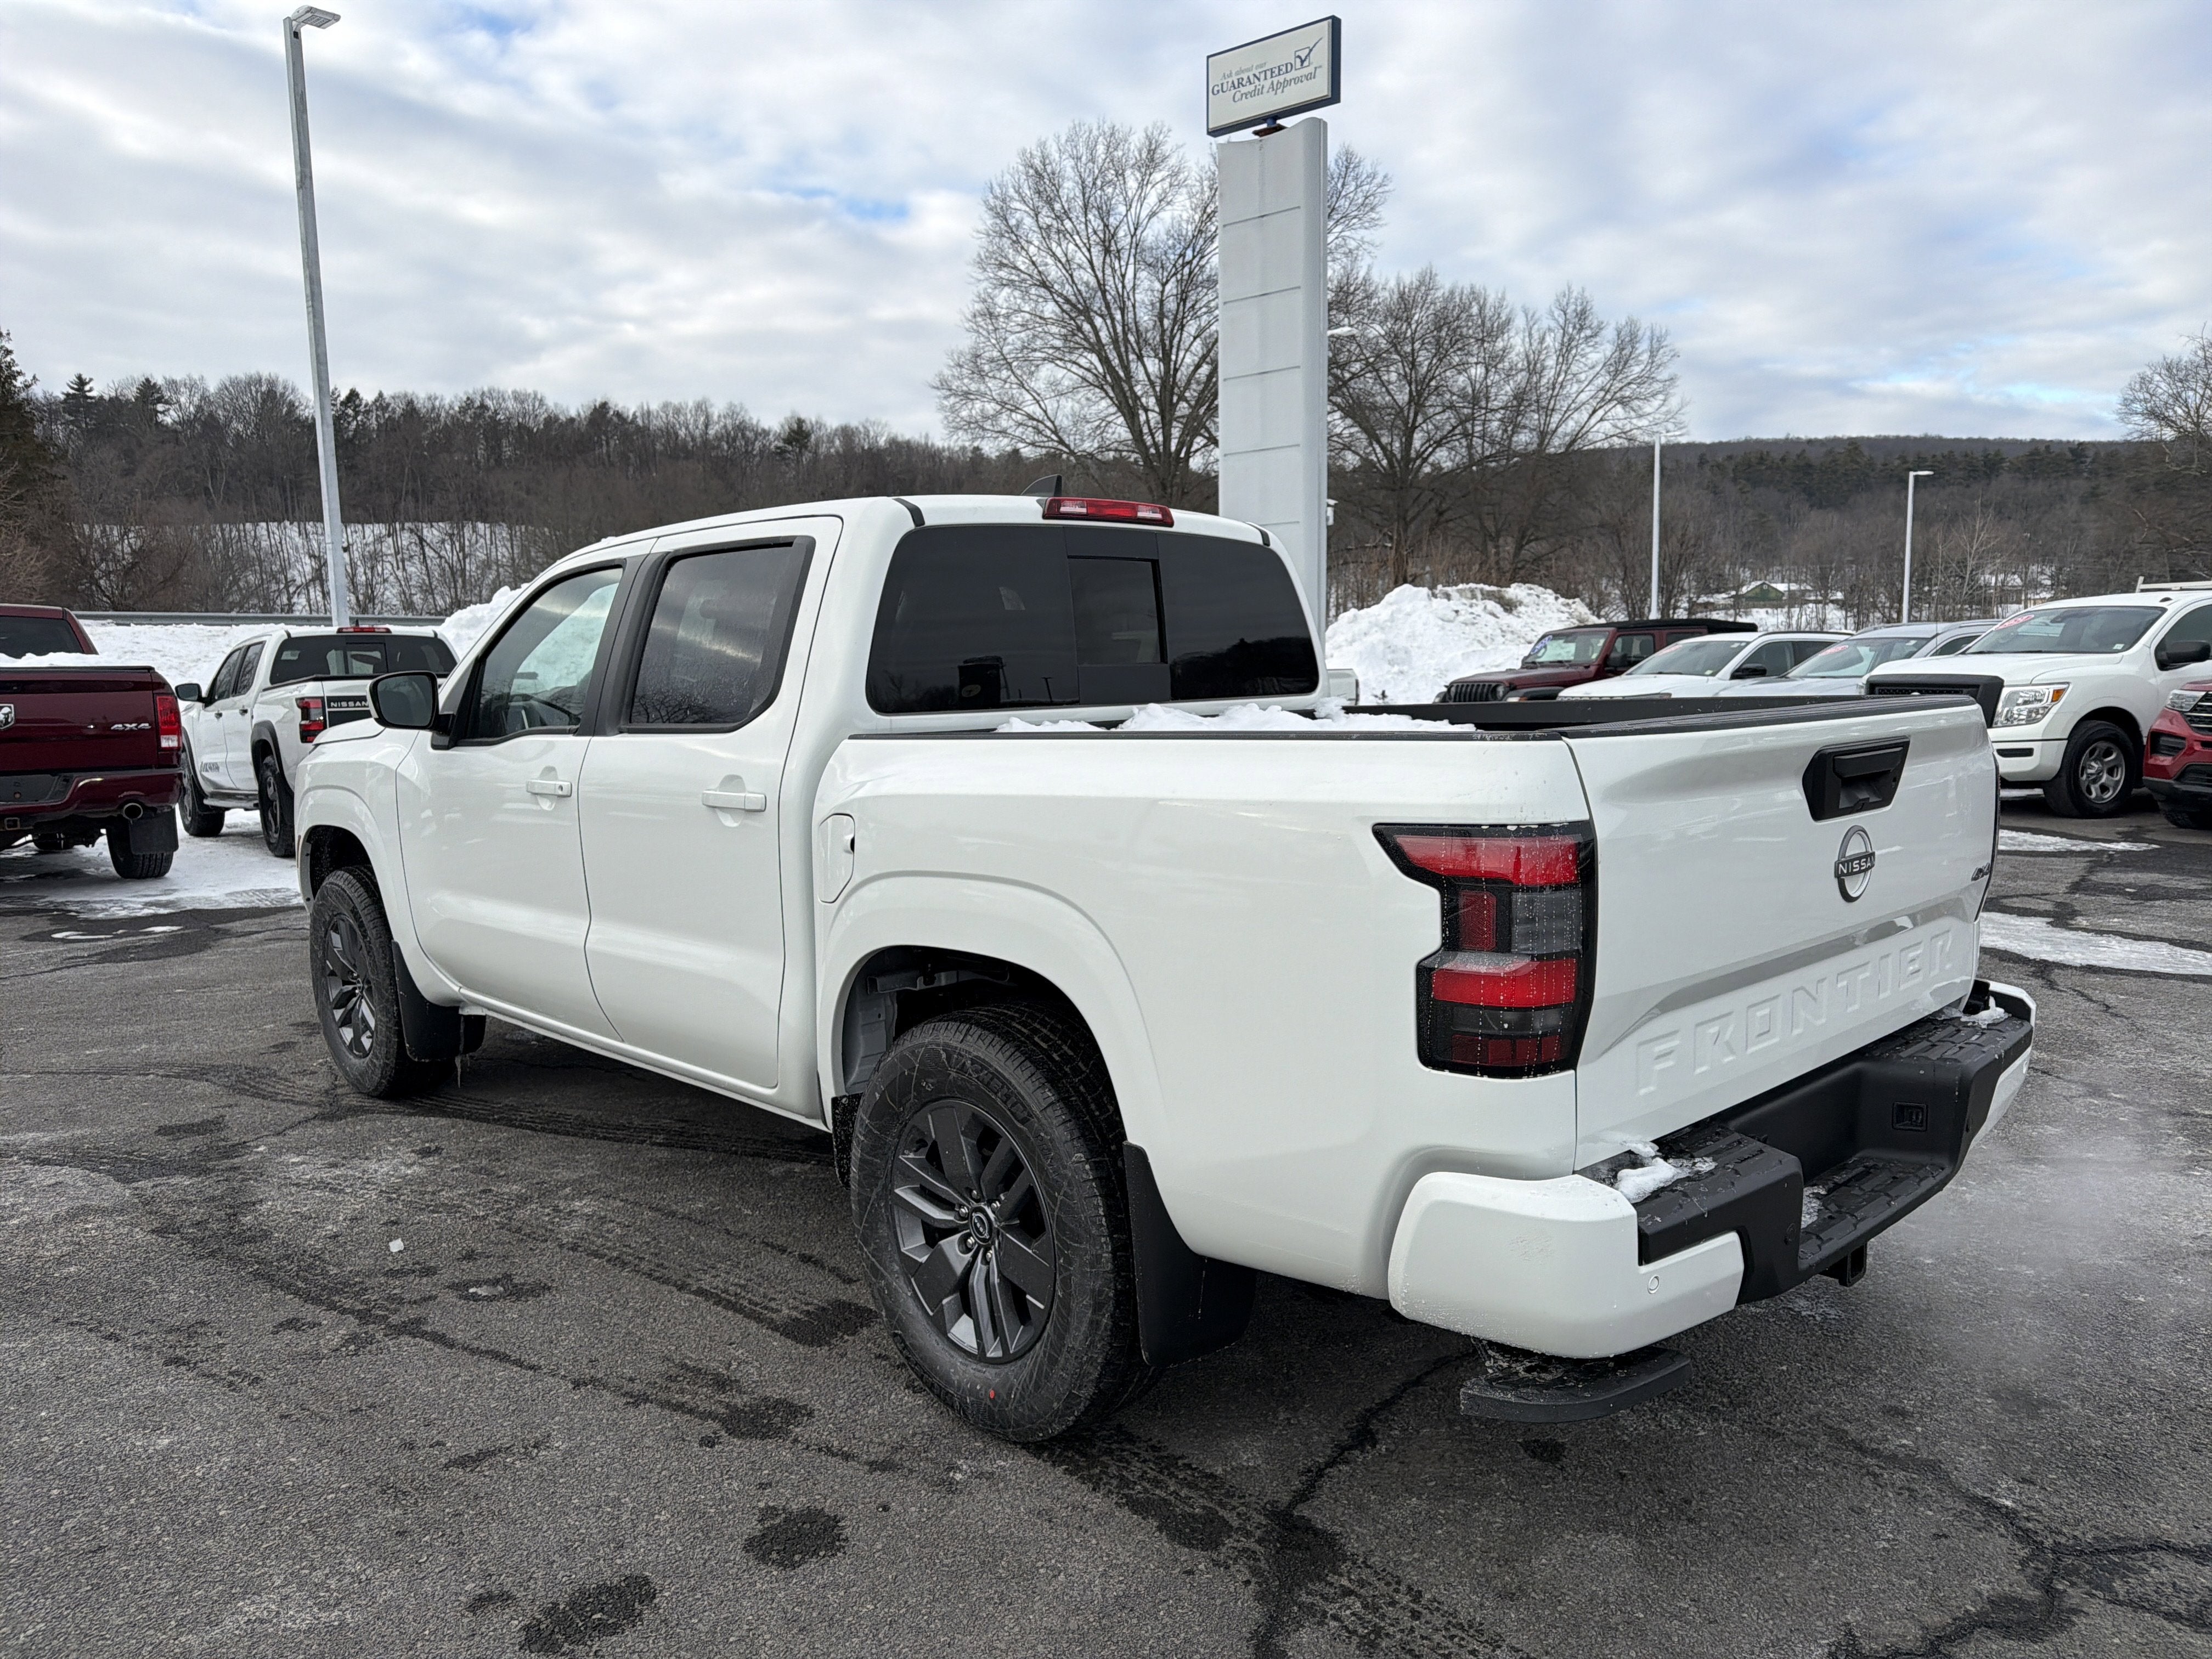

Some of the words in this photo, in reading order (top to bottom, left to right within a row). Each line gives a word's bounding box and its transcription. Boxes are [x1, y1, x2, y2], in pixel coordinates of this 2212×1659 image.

[1211, 62, 1293, 95] GUARANTEED
[1220, 70, 1233, 81] Ask
[1234, 65, 1254, 77] about
[1255, 62, 1268, 70] our
[1232, 84, 1264, 103] Credit
[1266, 66, 1317, 95] Approval
[1838, 856, 1875, 874] NISSAN
[1636, 930, 1951, 1096] FRONTIER
